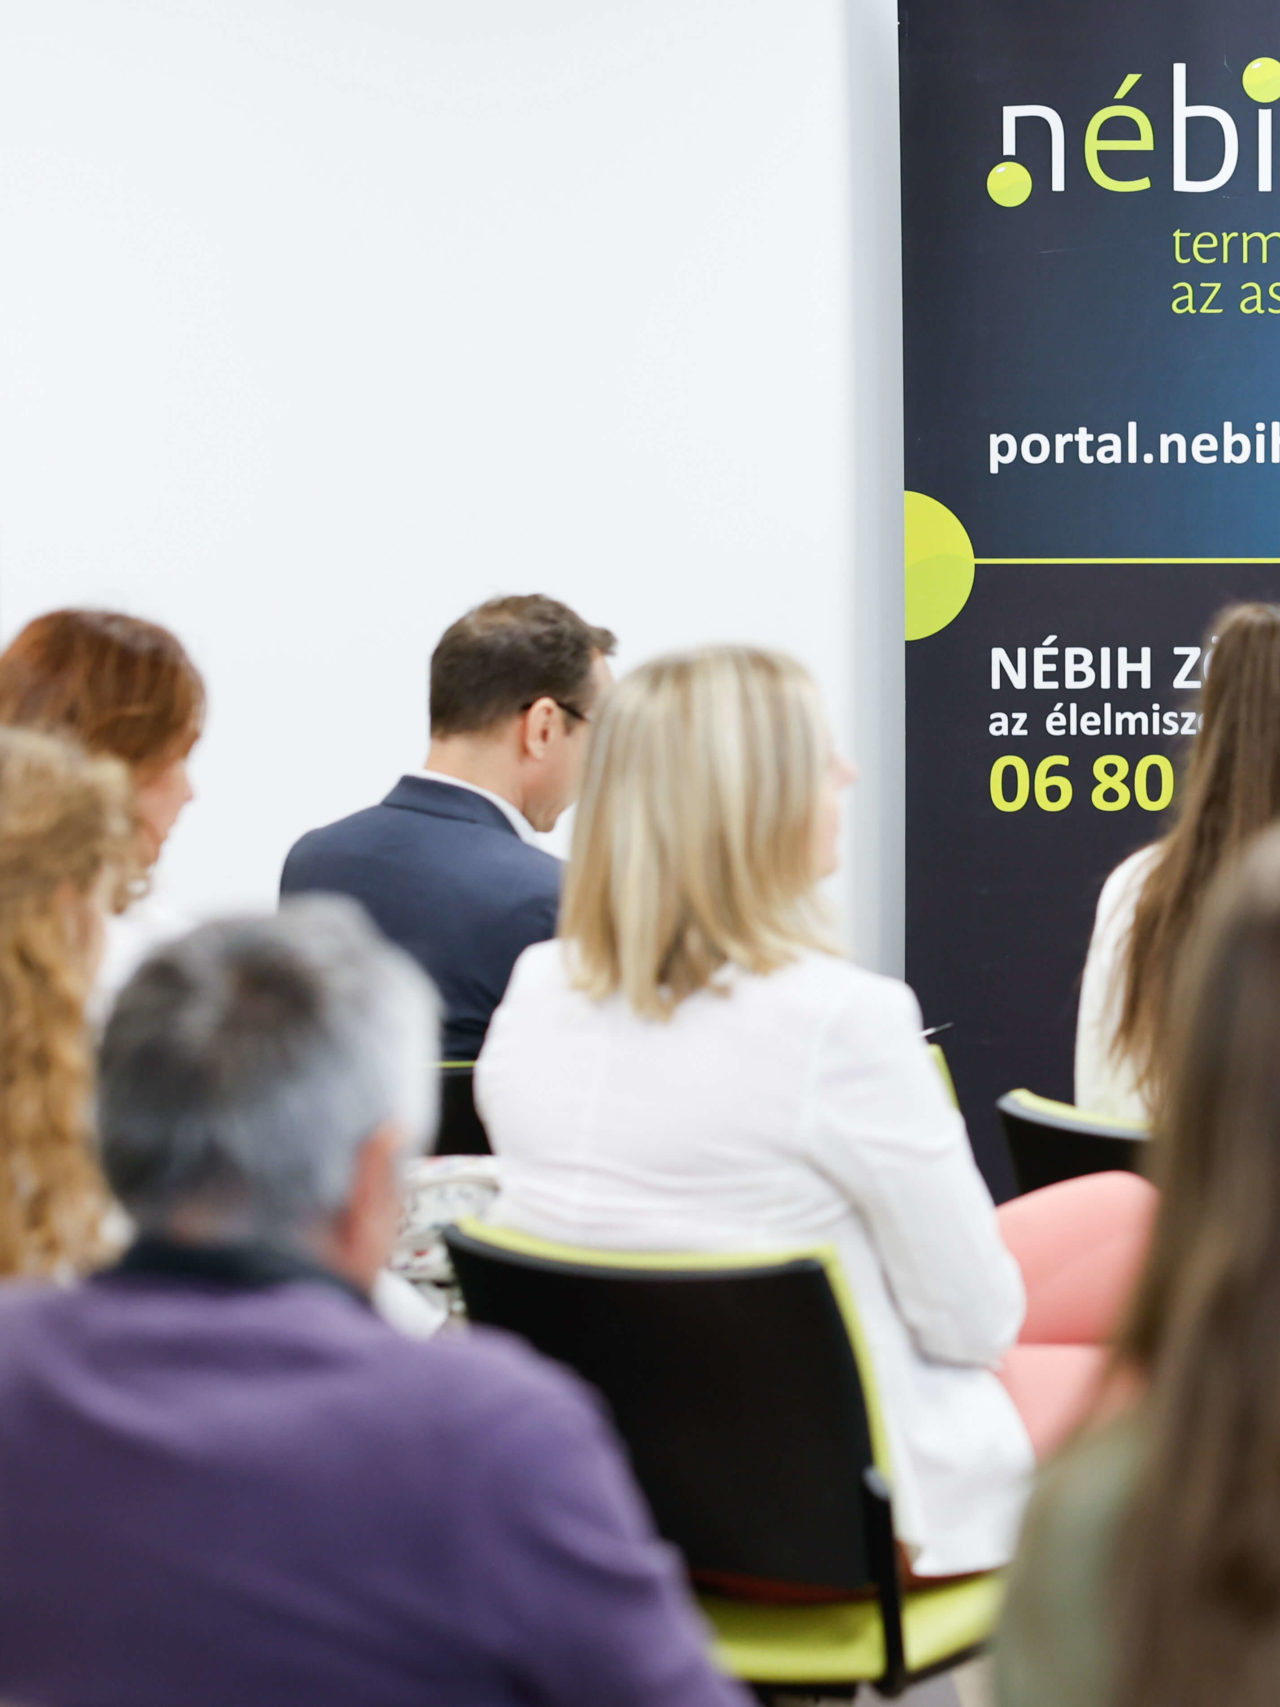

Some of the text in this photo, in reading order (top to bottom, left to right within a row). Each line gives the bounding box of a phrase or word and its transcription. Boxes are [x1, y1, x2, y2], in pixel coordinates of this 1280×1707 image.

[1171, 279, 1223, 314] az
[991, 634, 1152, 690] NÉBIH
[988, 712, 1028, 736] az
[1045, 702, 1204, 736] élelmisz
[989, 754, 1073, 813] 06
[1091, 754, 1175, 812] 80
